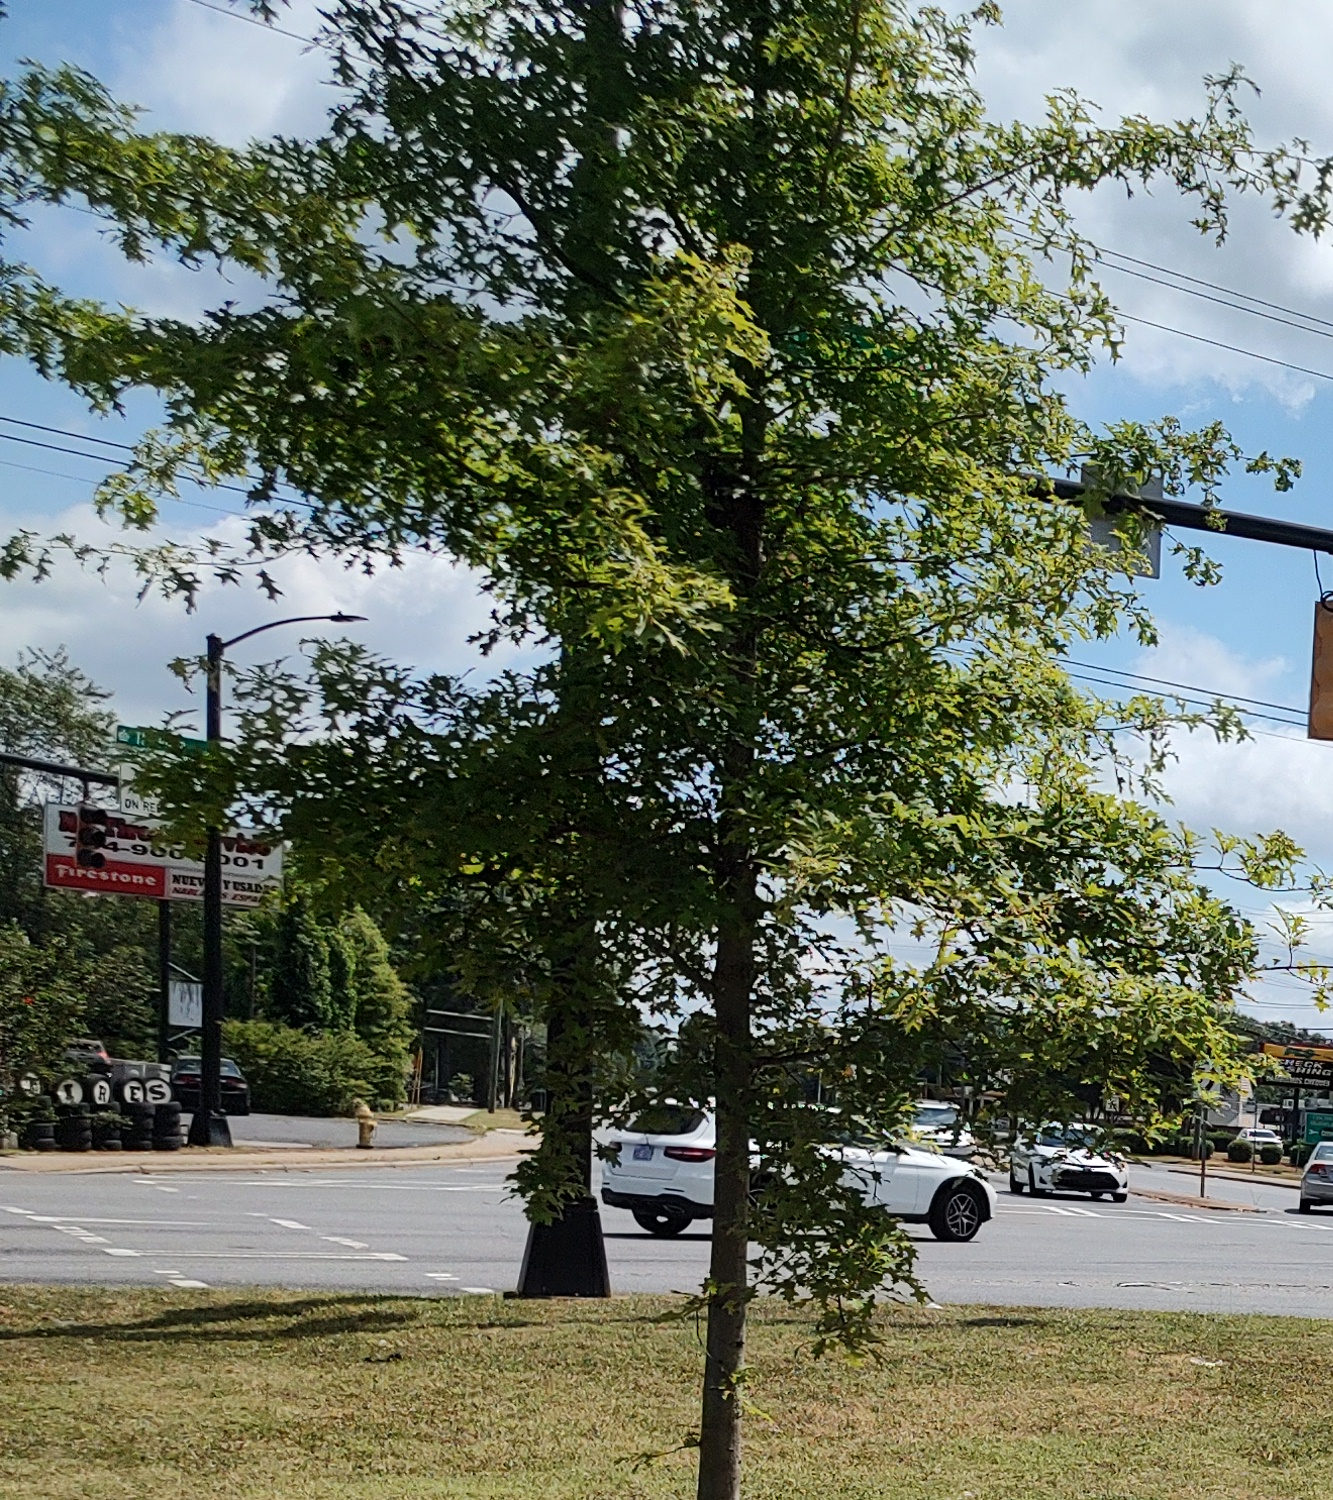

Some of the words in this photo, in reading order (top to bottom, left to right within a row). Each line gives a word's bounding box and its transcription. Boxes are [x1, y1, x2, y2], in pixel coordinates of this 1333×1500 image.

[124, 798, 139, 810] ON
[56, 864, 158, 887] Firestone
[1286, 1066, 1333, 1076] SHING
[29, 1080, 167, 1102] IRES
